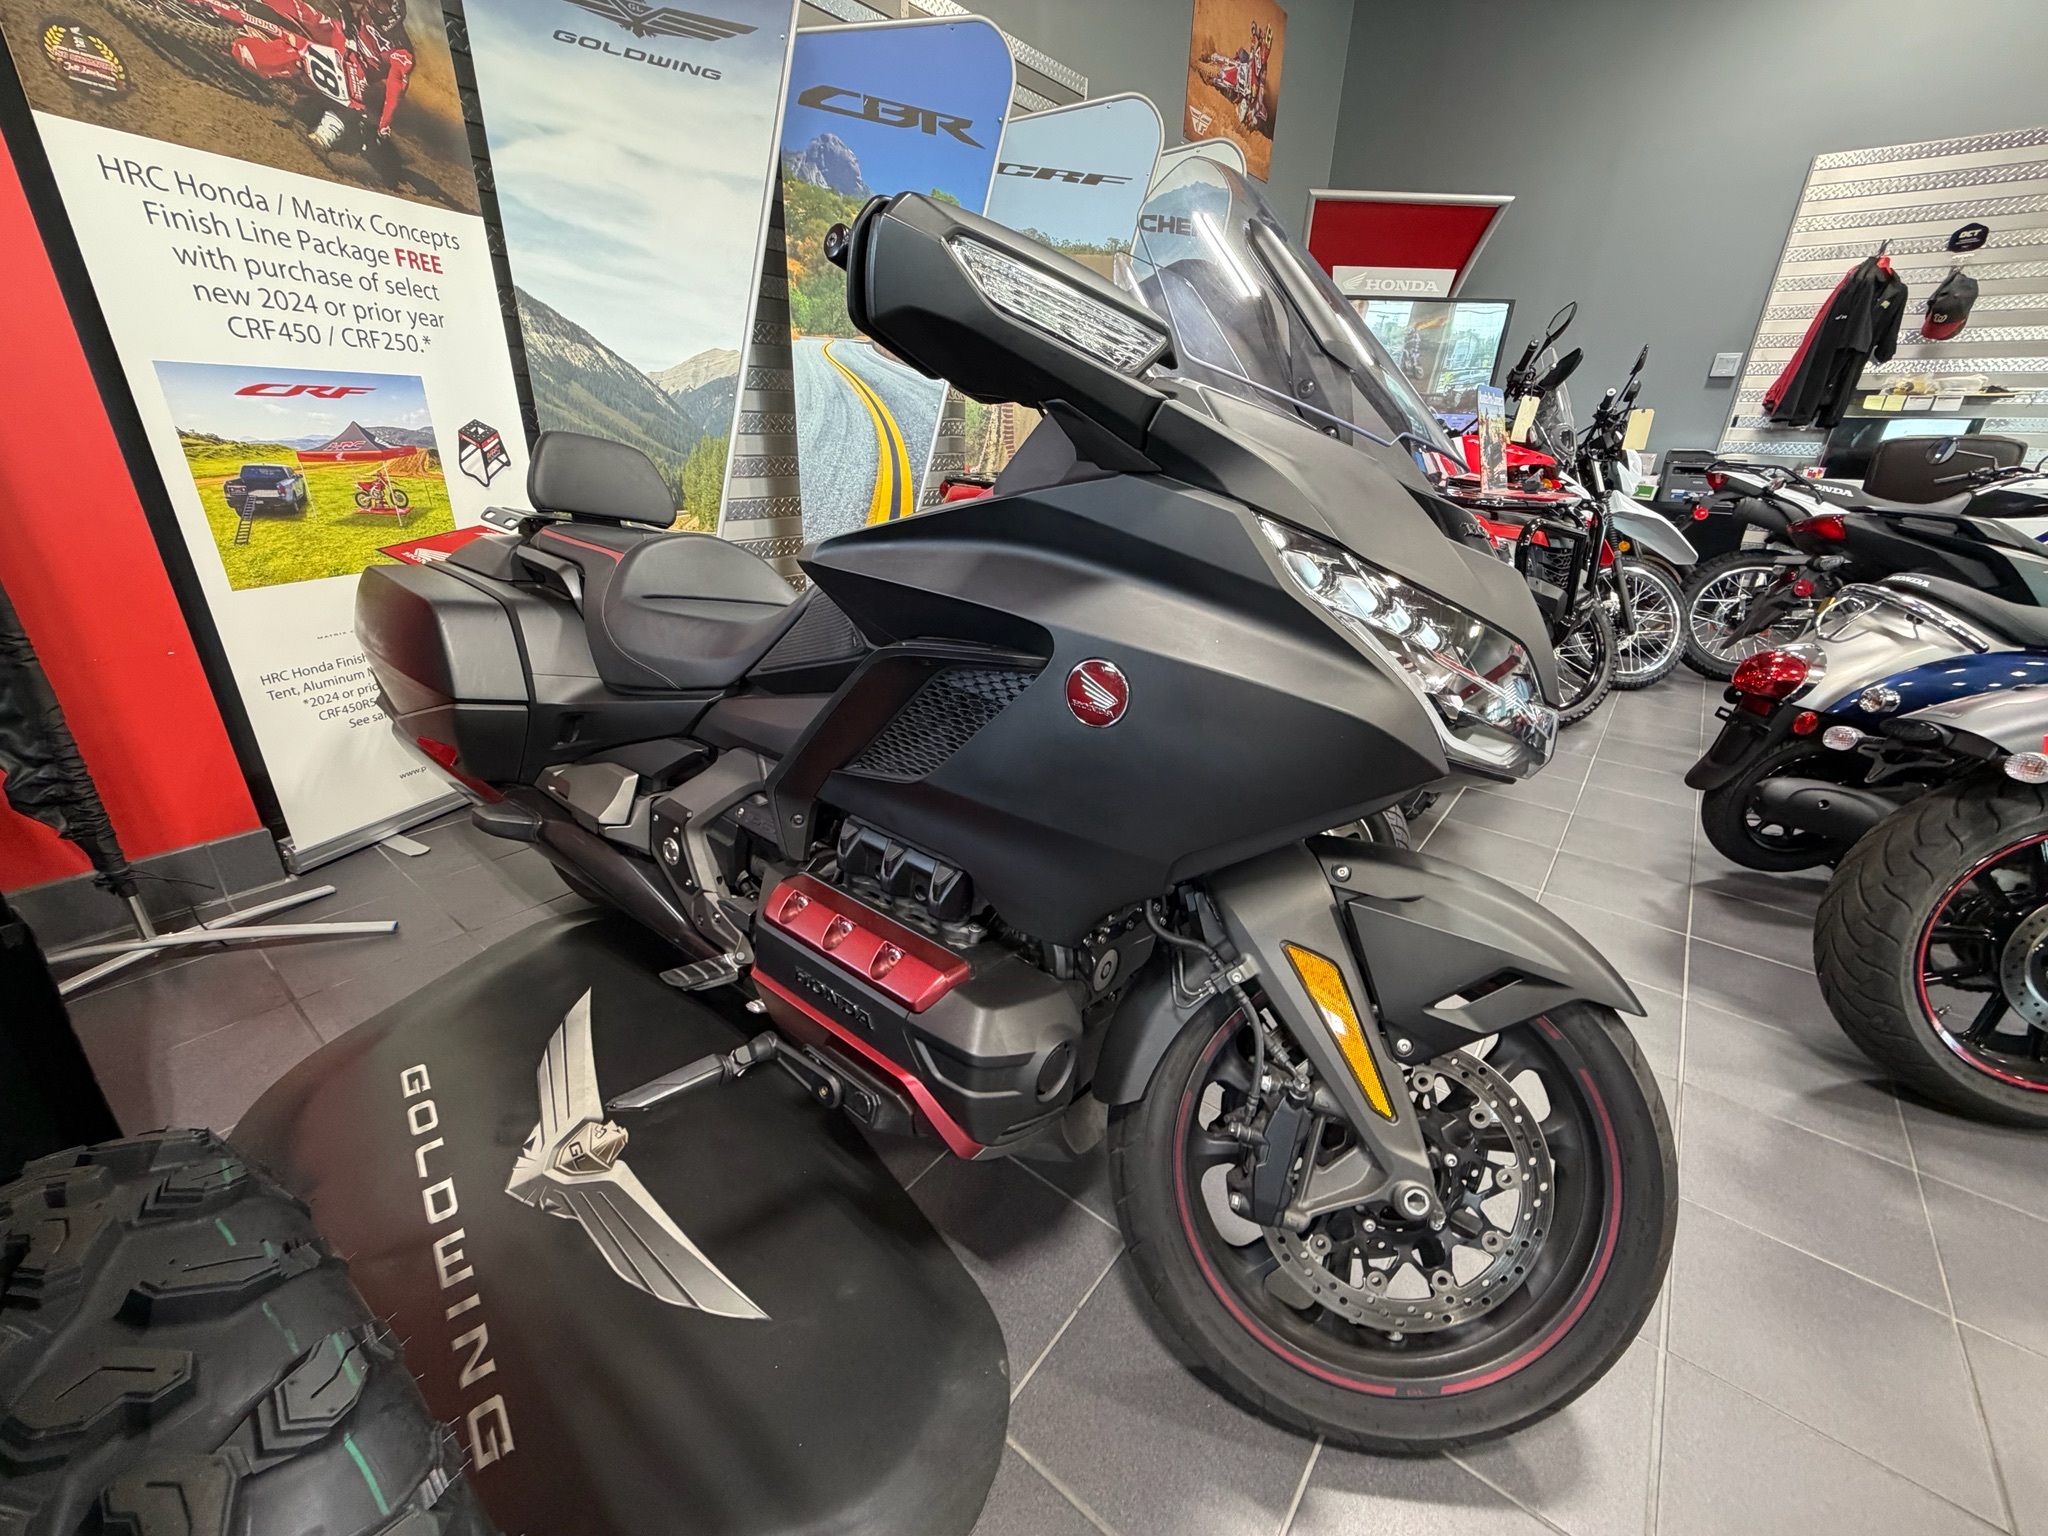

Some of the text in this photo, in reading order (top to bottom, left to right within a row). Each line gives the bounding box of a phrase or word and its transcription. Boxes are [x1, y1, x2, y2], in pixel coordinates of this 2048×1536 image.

[552, 29, 722, 81] GOLDWING
[308, 49, 340, 97] 18
[798, 85, 986, 149] CBR
[997, 162, 1133, 186] CRF
[97, 154, 169, 192] HRC
[174, 170, 270, 214] Honda
[292, 196, 366, 232] Matrix
[370, 214, 460, 252] Concepts
[143, 201, 444, 275] Finish Line Package FREE
[1140, 214, 1197, 237] CHE
[172, 245, 441, 301] with purchase of select
[1364, 279, 1440, 292] HONDA
[193, 282, 445, 330] new 2024 or prior year
[227, 316, 321, 345] CRF450
[234, 383, 377, 399] CRF
[260, 670, 290, 686] HRC
[292, 661, 334, 679] Honda
[266, 687, 301, 702] Tent,
[303, 670, 366, 693] Aluminum
[342, 689, 355, 700] or
[357, 681, 381, 696] prio
[348, 715, 370, 729] See
[795, 966, 874, 1032] HONDA
[569, 1141, 587, 1171] GL
[400, 1063, 515, 1472] GOLDWING
